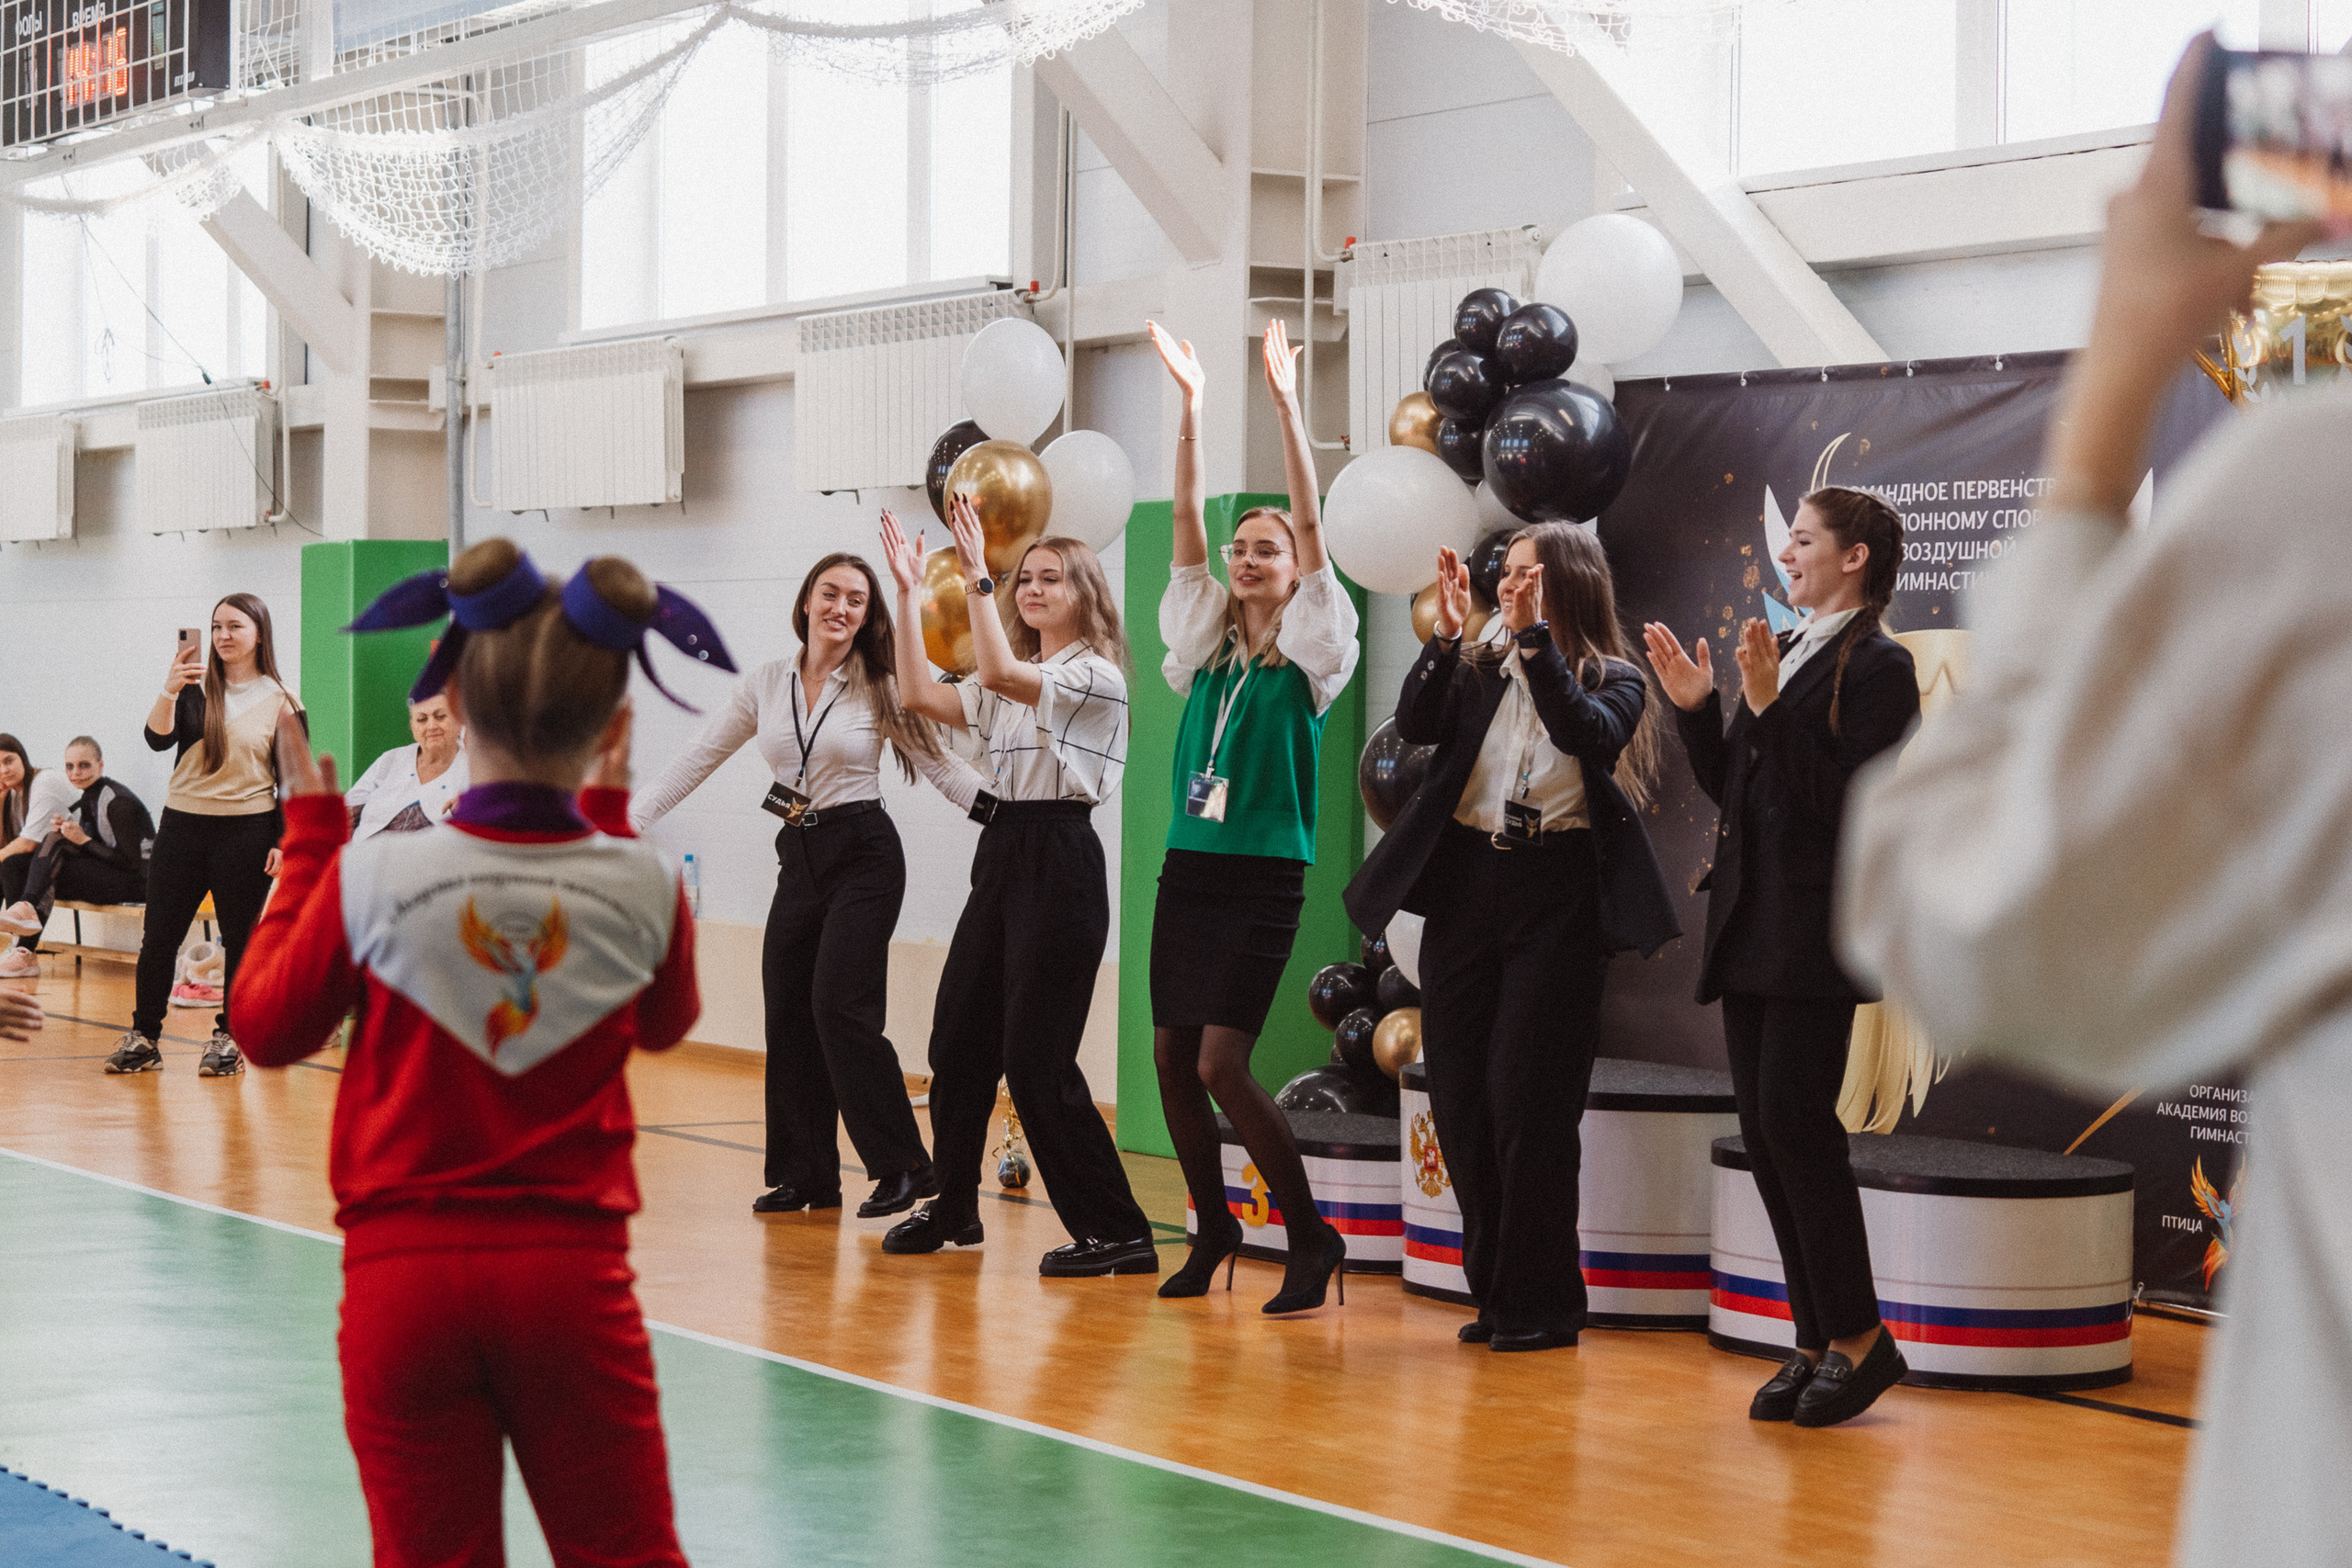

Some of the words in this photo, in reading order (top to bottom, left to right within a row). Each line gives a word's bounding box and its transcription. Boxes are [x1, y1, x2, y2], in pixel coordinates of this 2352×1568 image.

[2279, 312, 2307, 385] 1
[2156, 1102, 2227, 1121] АКАДЕМИЯ
[1241, 1163, 1271, 1228] 3
[2162, 1215, 2203, 1234] ПТИЦА
